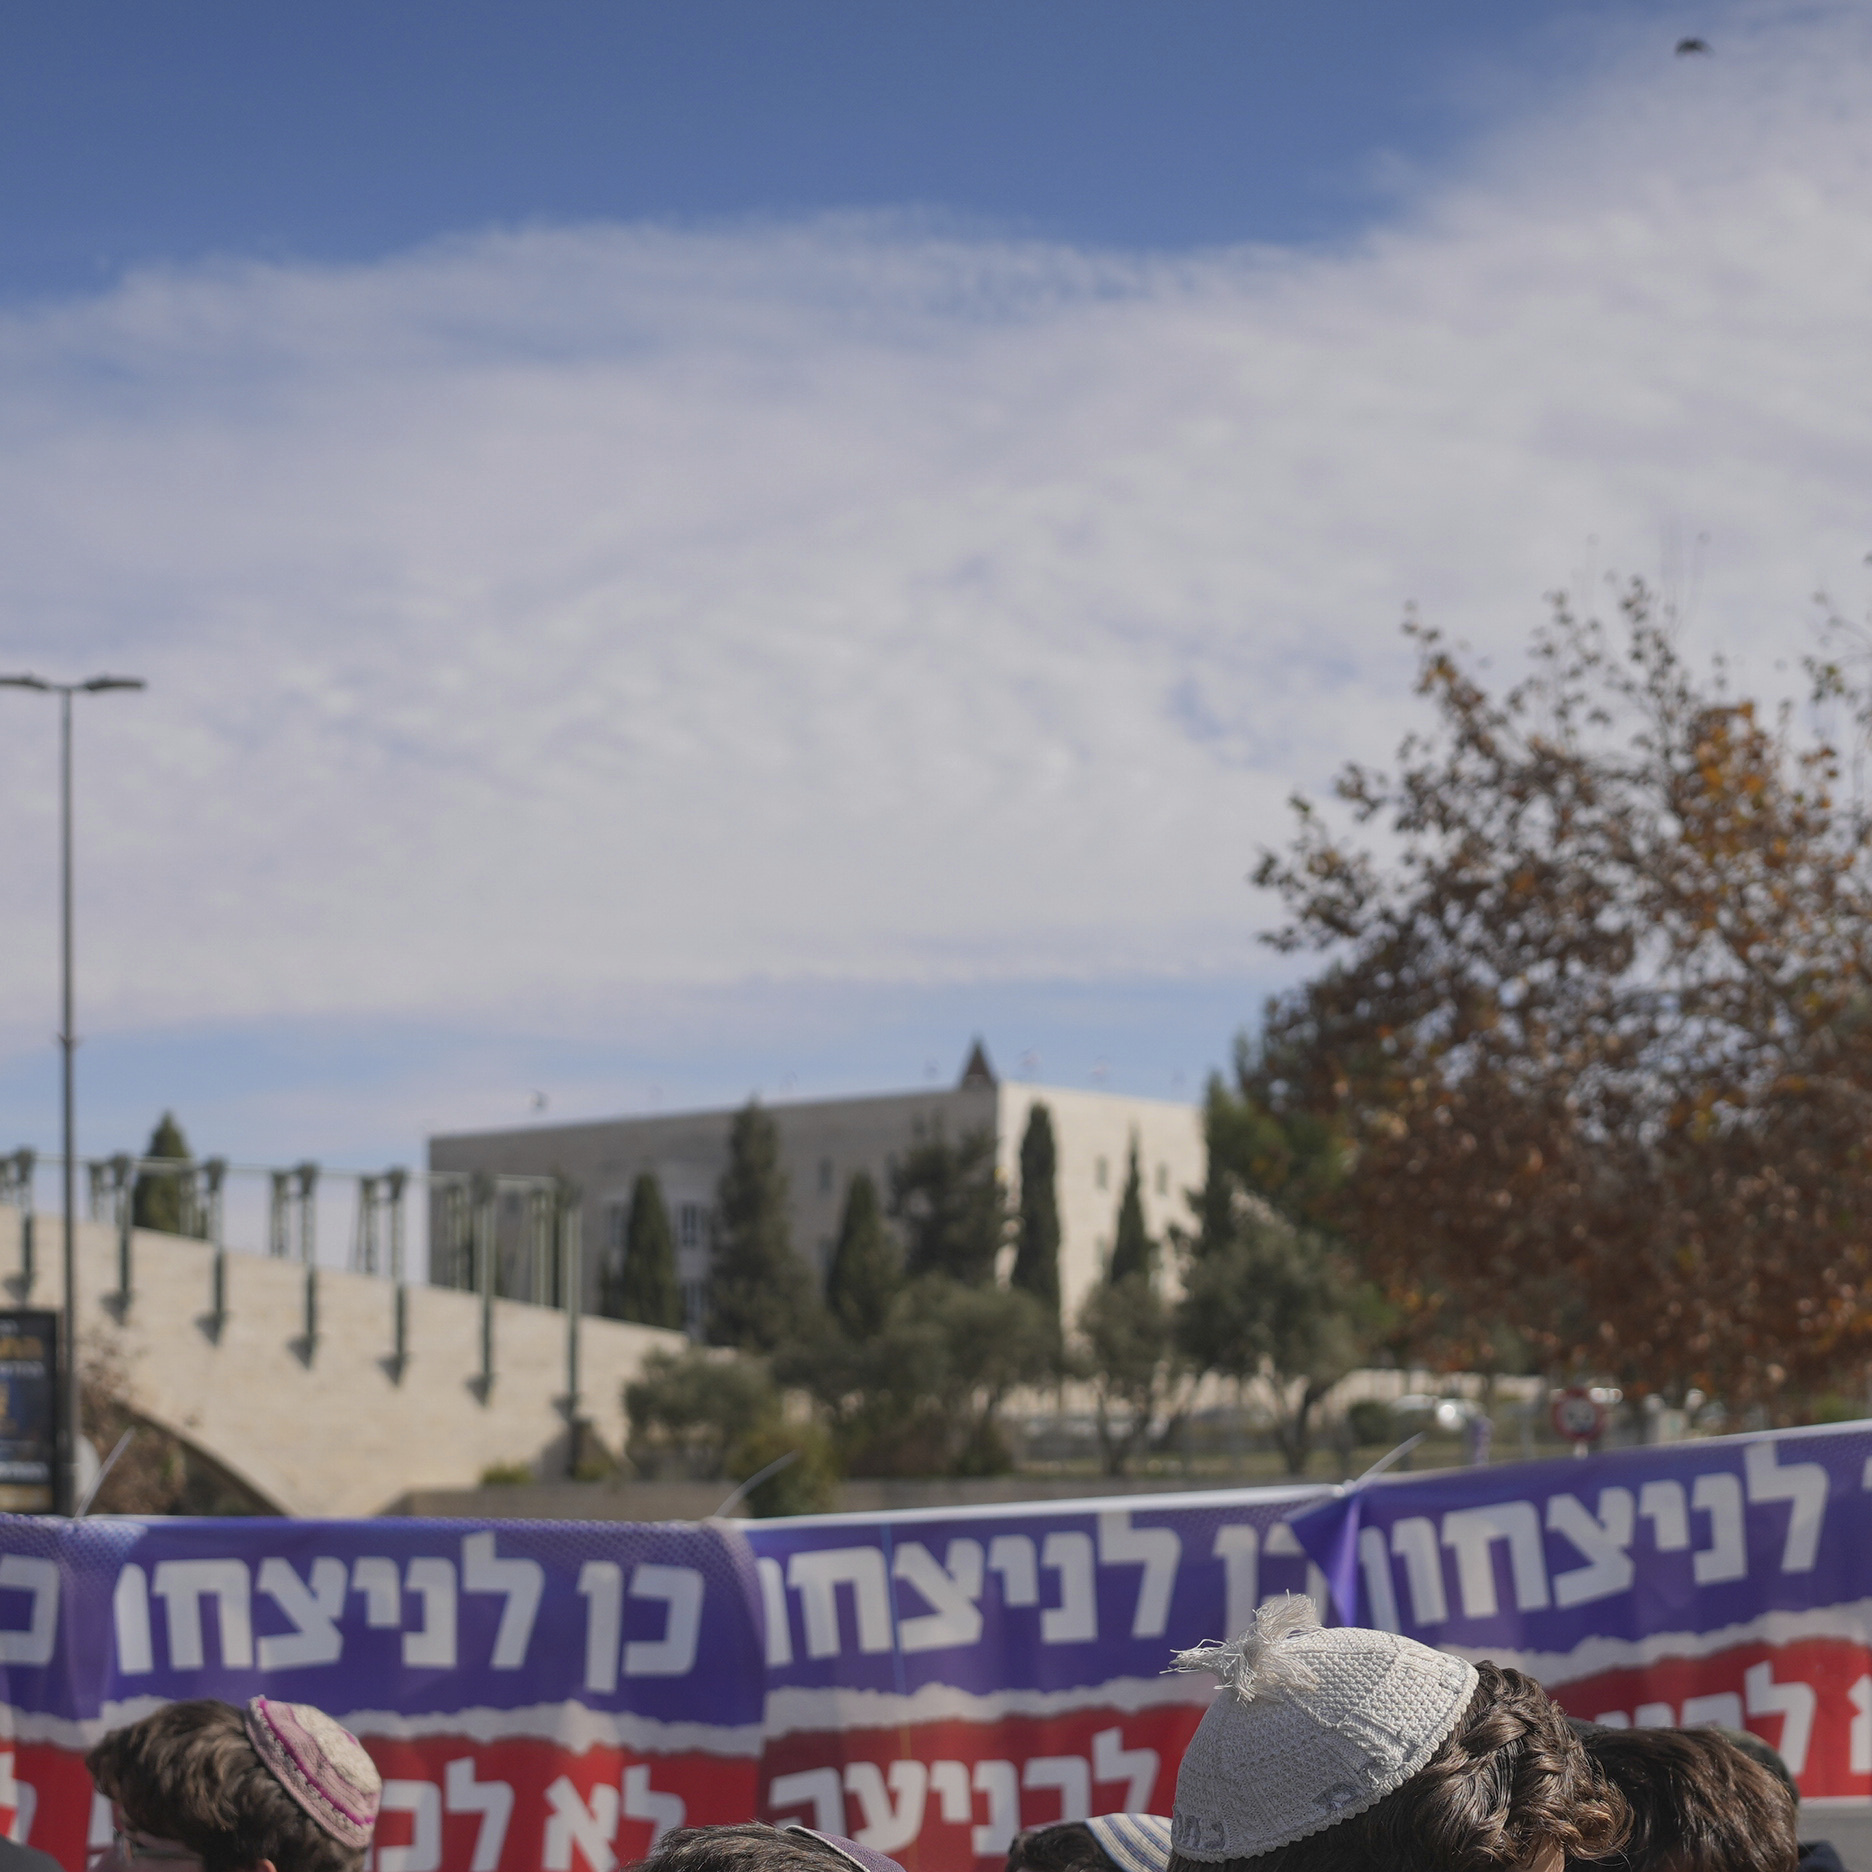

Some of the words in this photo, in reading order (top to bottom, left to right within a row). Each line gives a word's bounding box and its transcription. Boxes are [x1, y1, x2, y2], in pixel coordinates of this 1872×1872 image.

[113, 1530, 546, 1675] לניצחו
[760, 1512, 1183, 1668] לניצחו
[1359, 1441, 1829, 1634] לניצחון
[576, 1560, 705, 1696] כן
